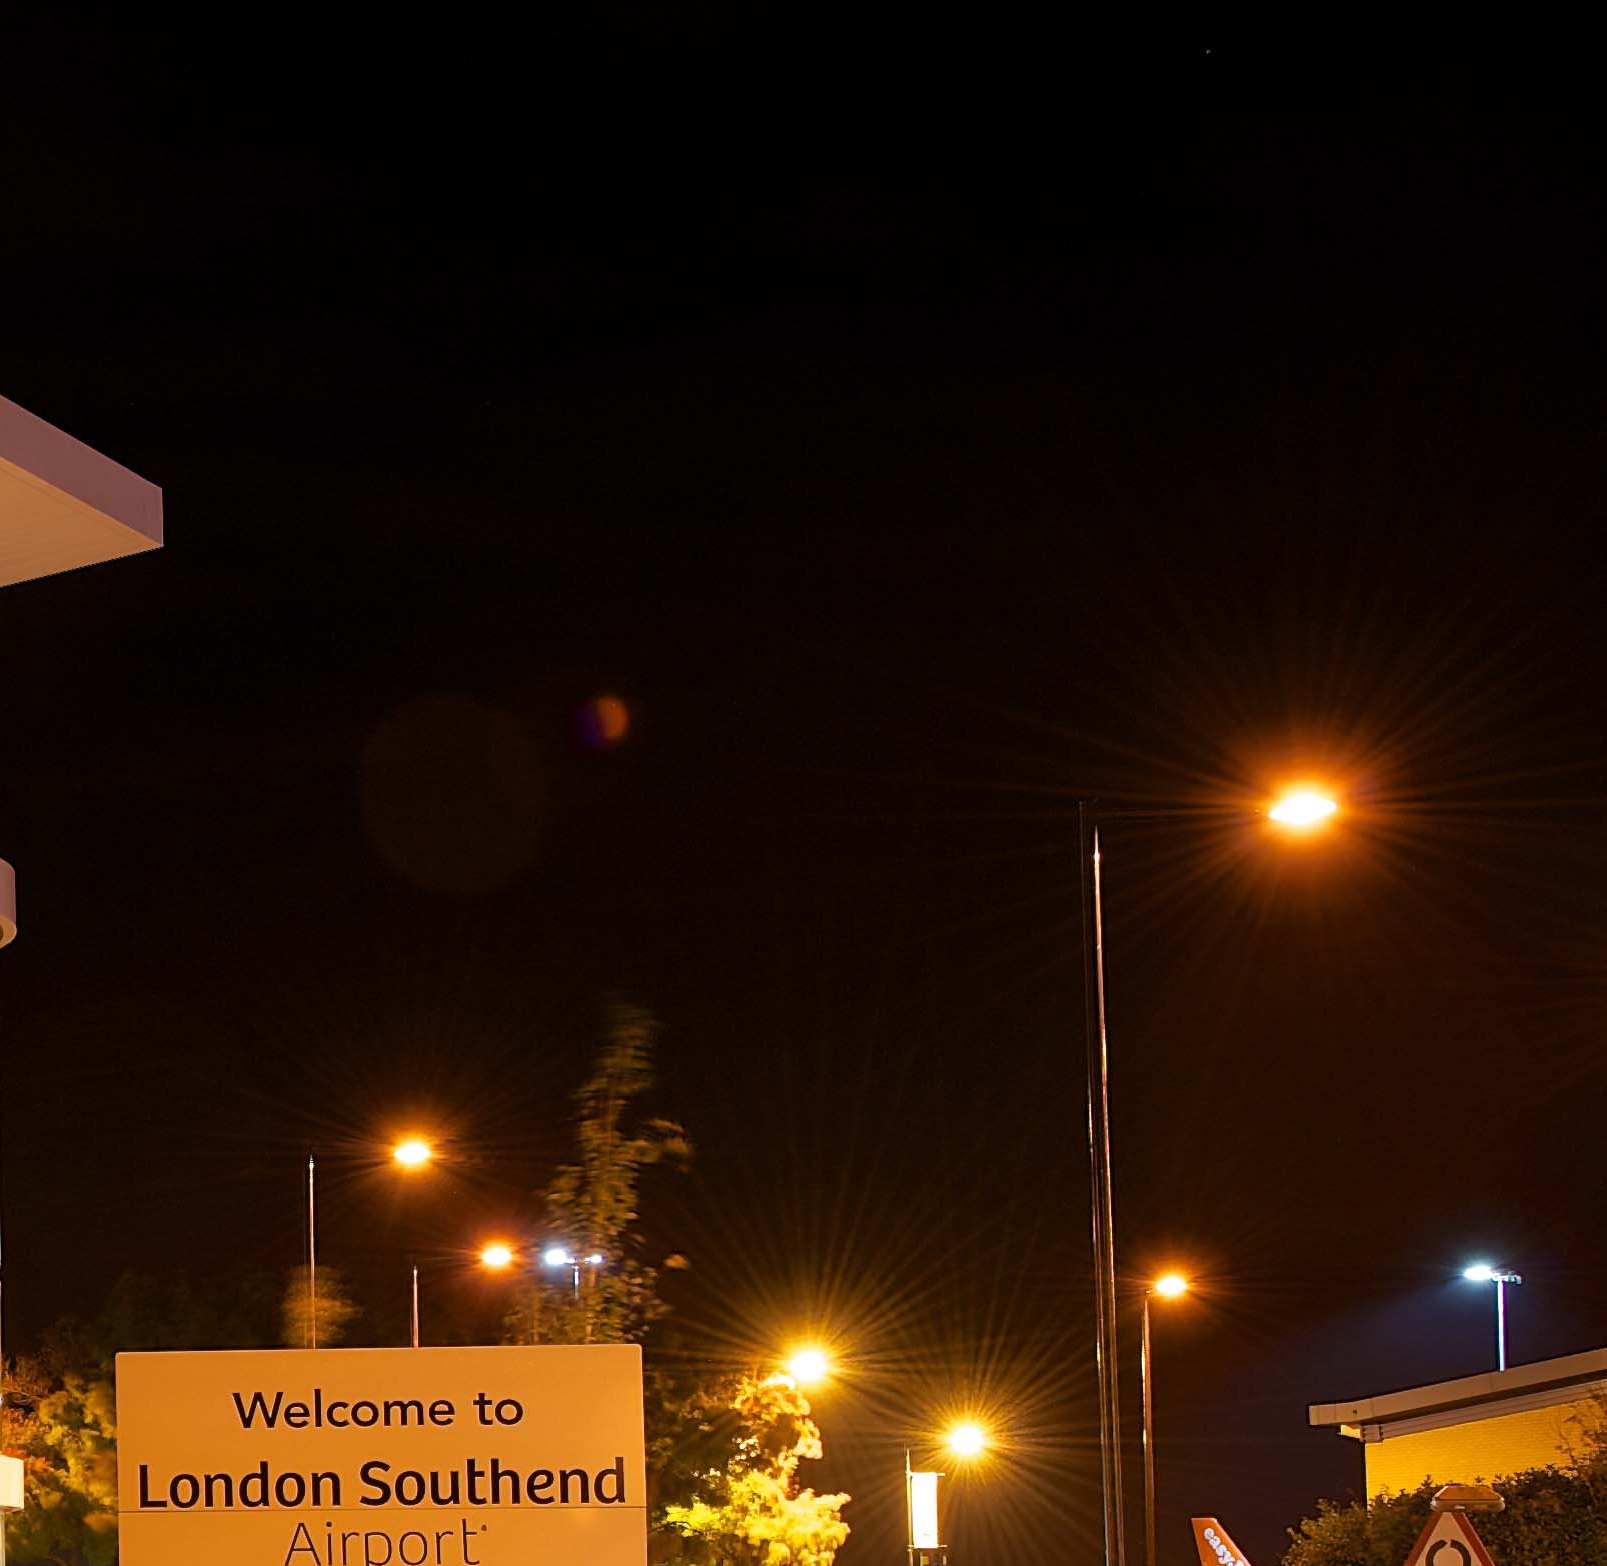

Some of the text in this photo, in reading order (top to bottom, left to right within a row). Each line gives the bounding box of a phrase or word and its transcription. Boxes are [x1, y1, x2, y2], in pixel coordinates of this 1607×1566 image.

[232, 1388, 524, 1429] Welcome to
[138, 1457, 626, 1508] London Southend
